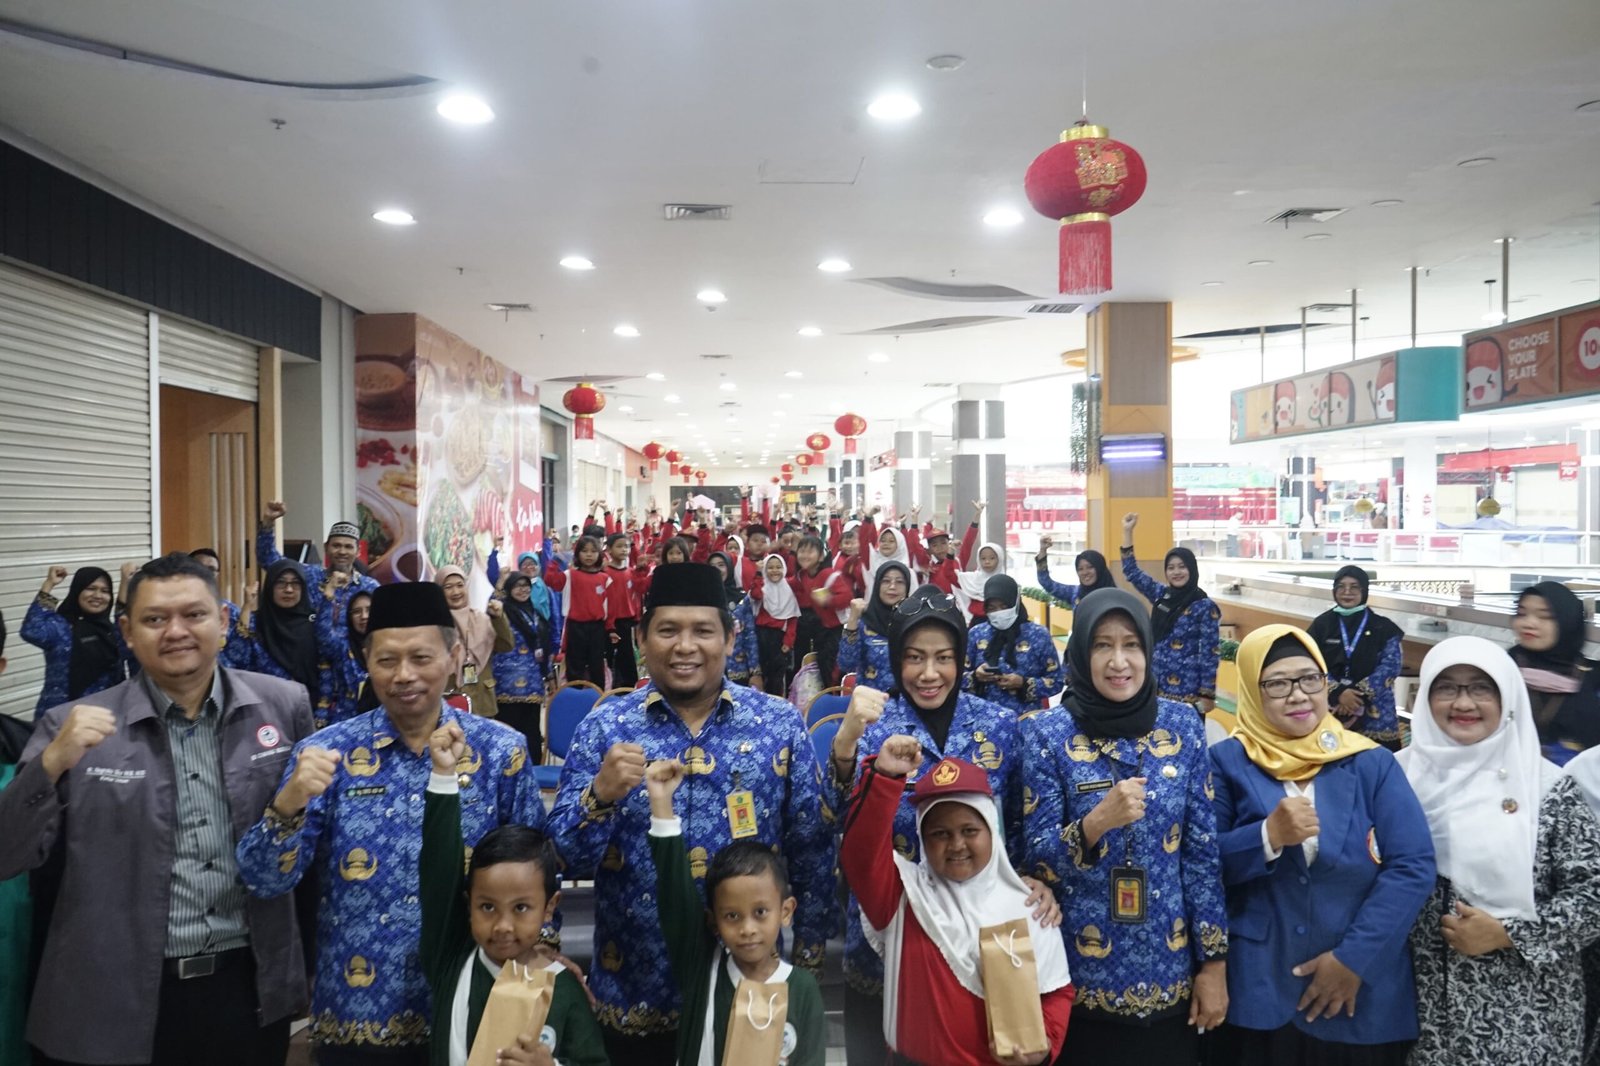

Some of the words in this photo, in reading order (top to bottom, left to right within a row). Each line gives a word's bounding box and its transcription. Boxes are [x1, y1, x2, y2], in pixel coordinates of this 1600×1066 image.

[1508, 331, 1550, 351] CHOOSE
[1584, 339, 1600, 357] 10
[1508, 349, 1537, 366] YOUR
[1508, 364, 1537, 381] PLATE
